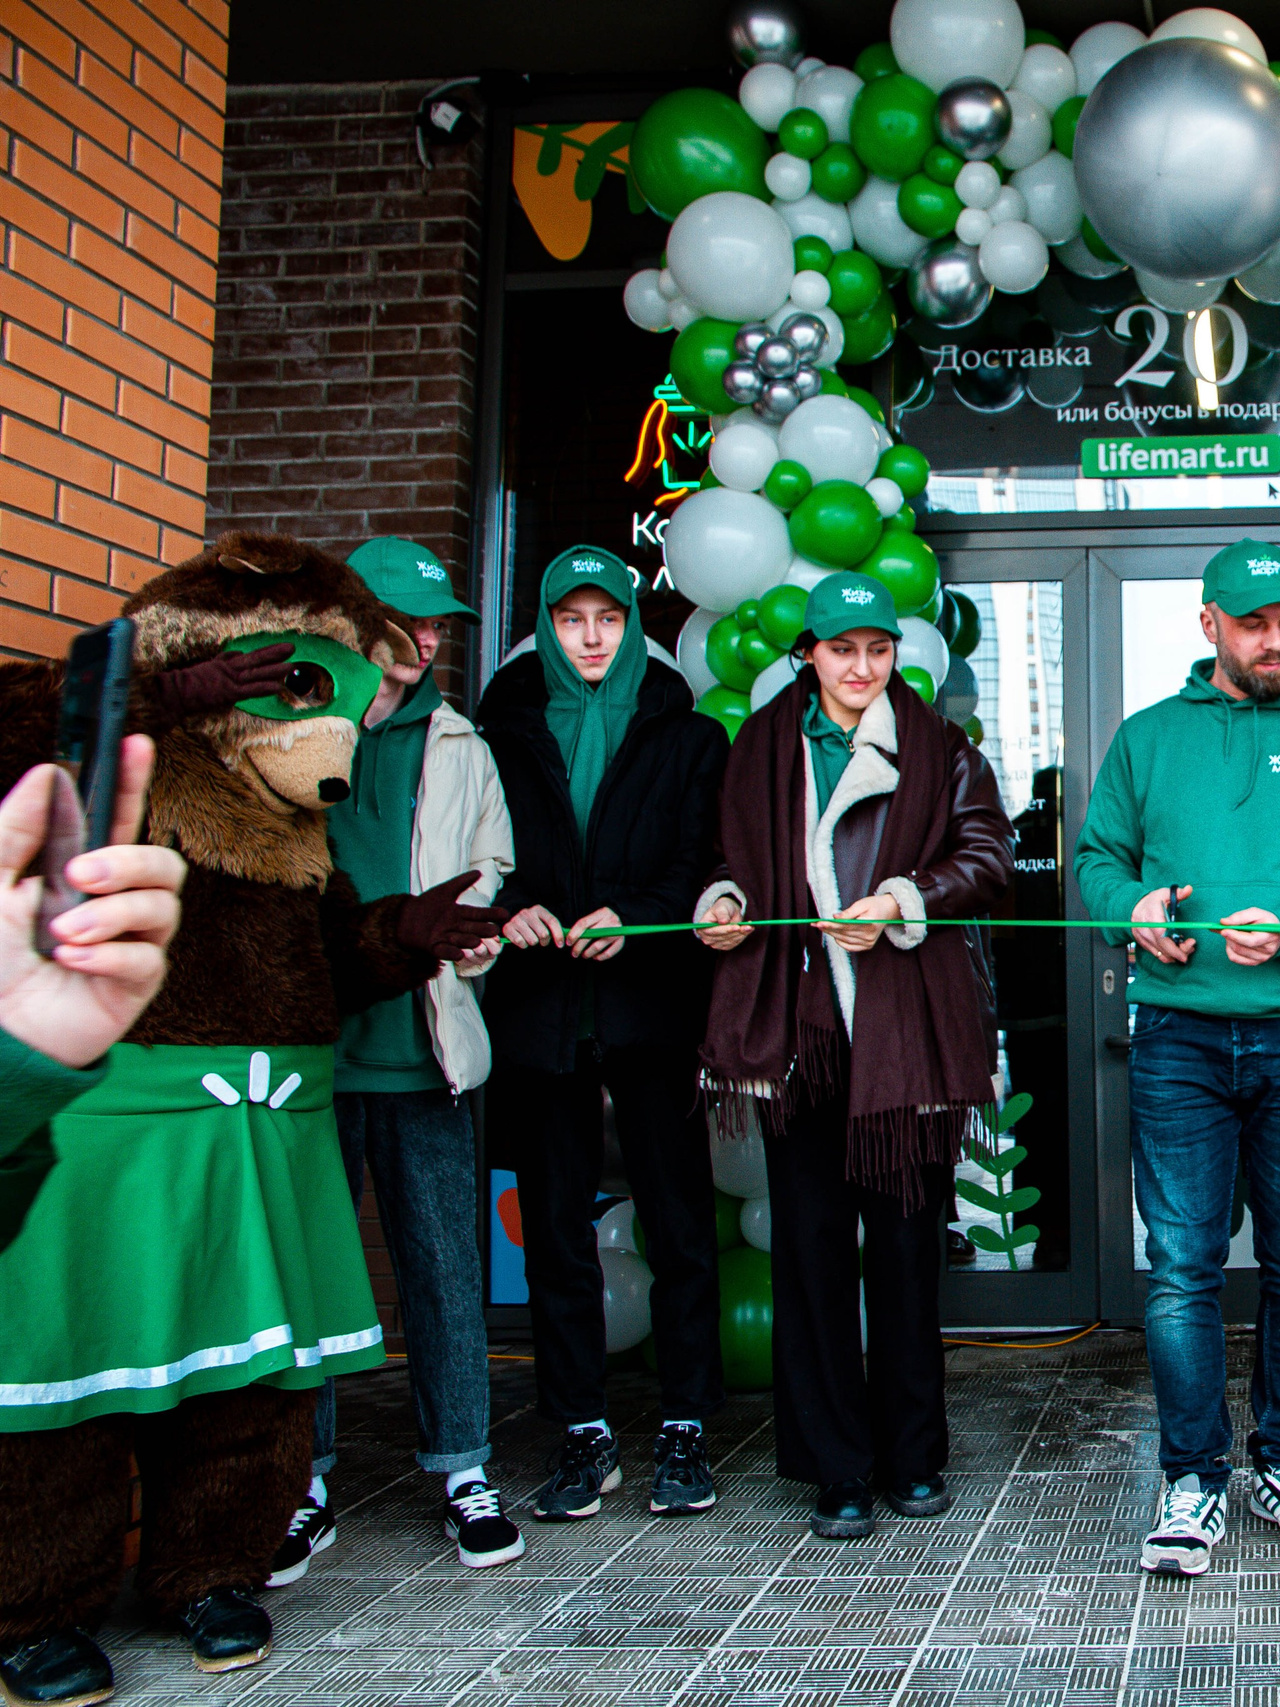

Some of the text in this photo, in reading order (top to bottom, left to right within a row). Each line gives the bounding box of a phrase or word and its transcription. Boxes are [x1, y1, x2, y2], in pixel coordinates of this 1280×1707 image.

[932, 343, 1092, 376] Доставка
[1113, 303, 1249, 388] 20
[1056, 403, 1099, 423] или
[1104, 400, 1193, 424] бонусы
[1096, 442, 1270, 472] lifemart.ru
